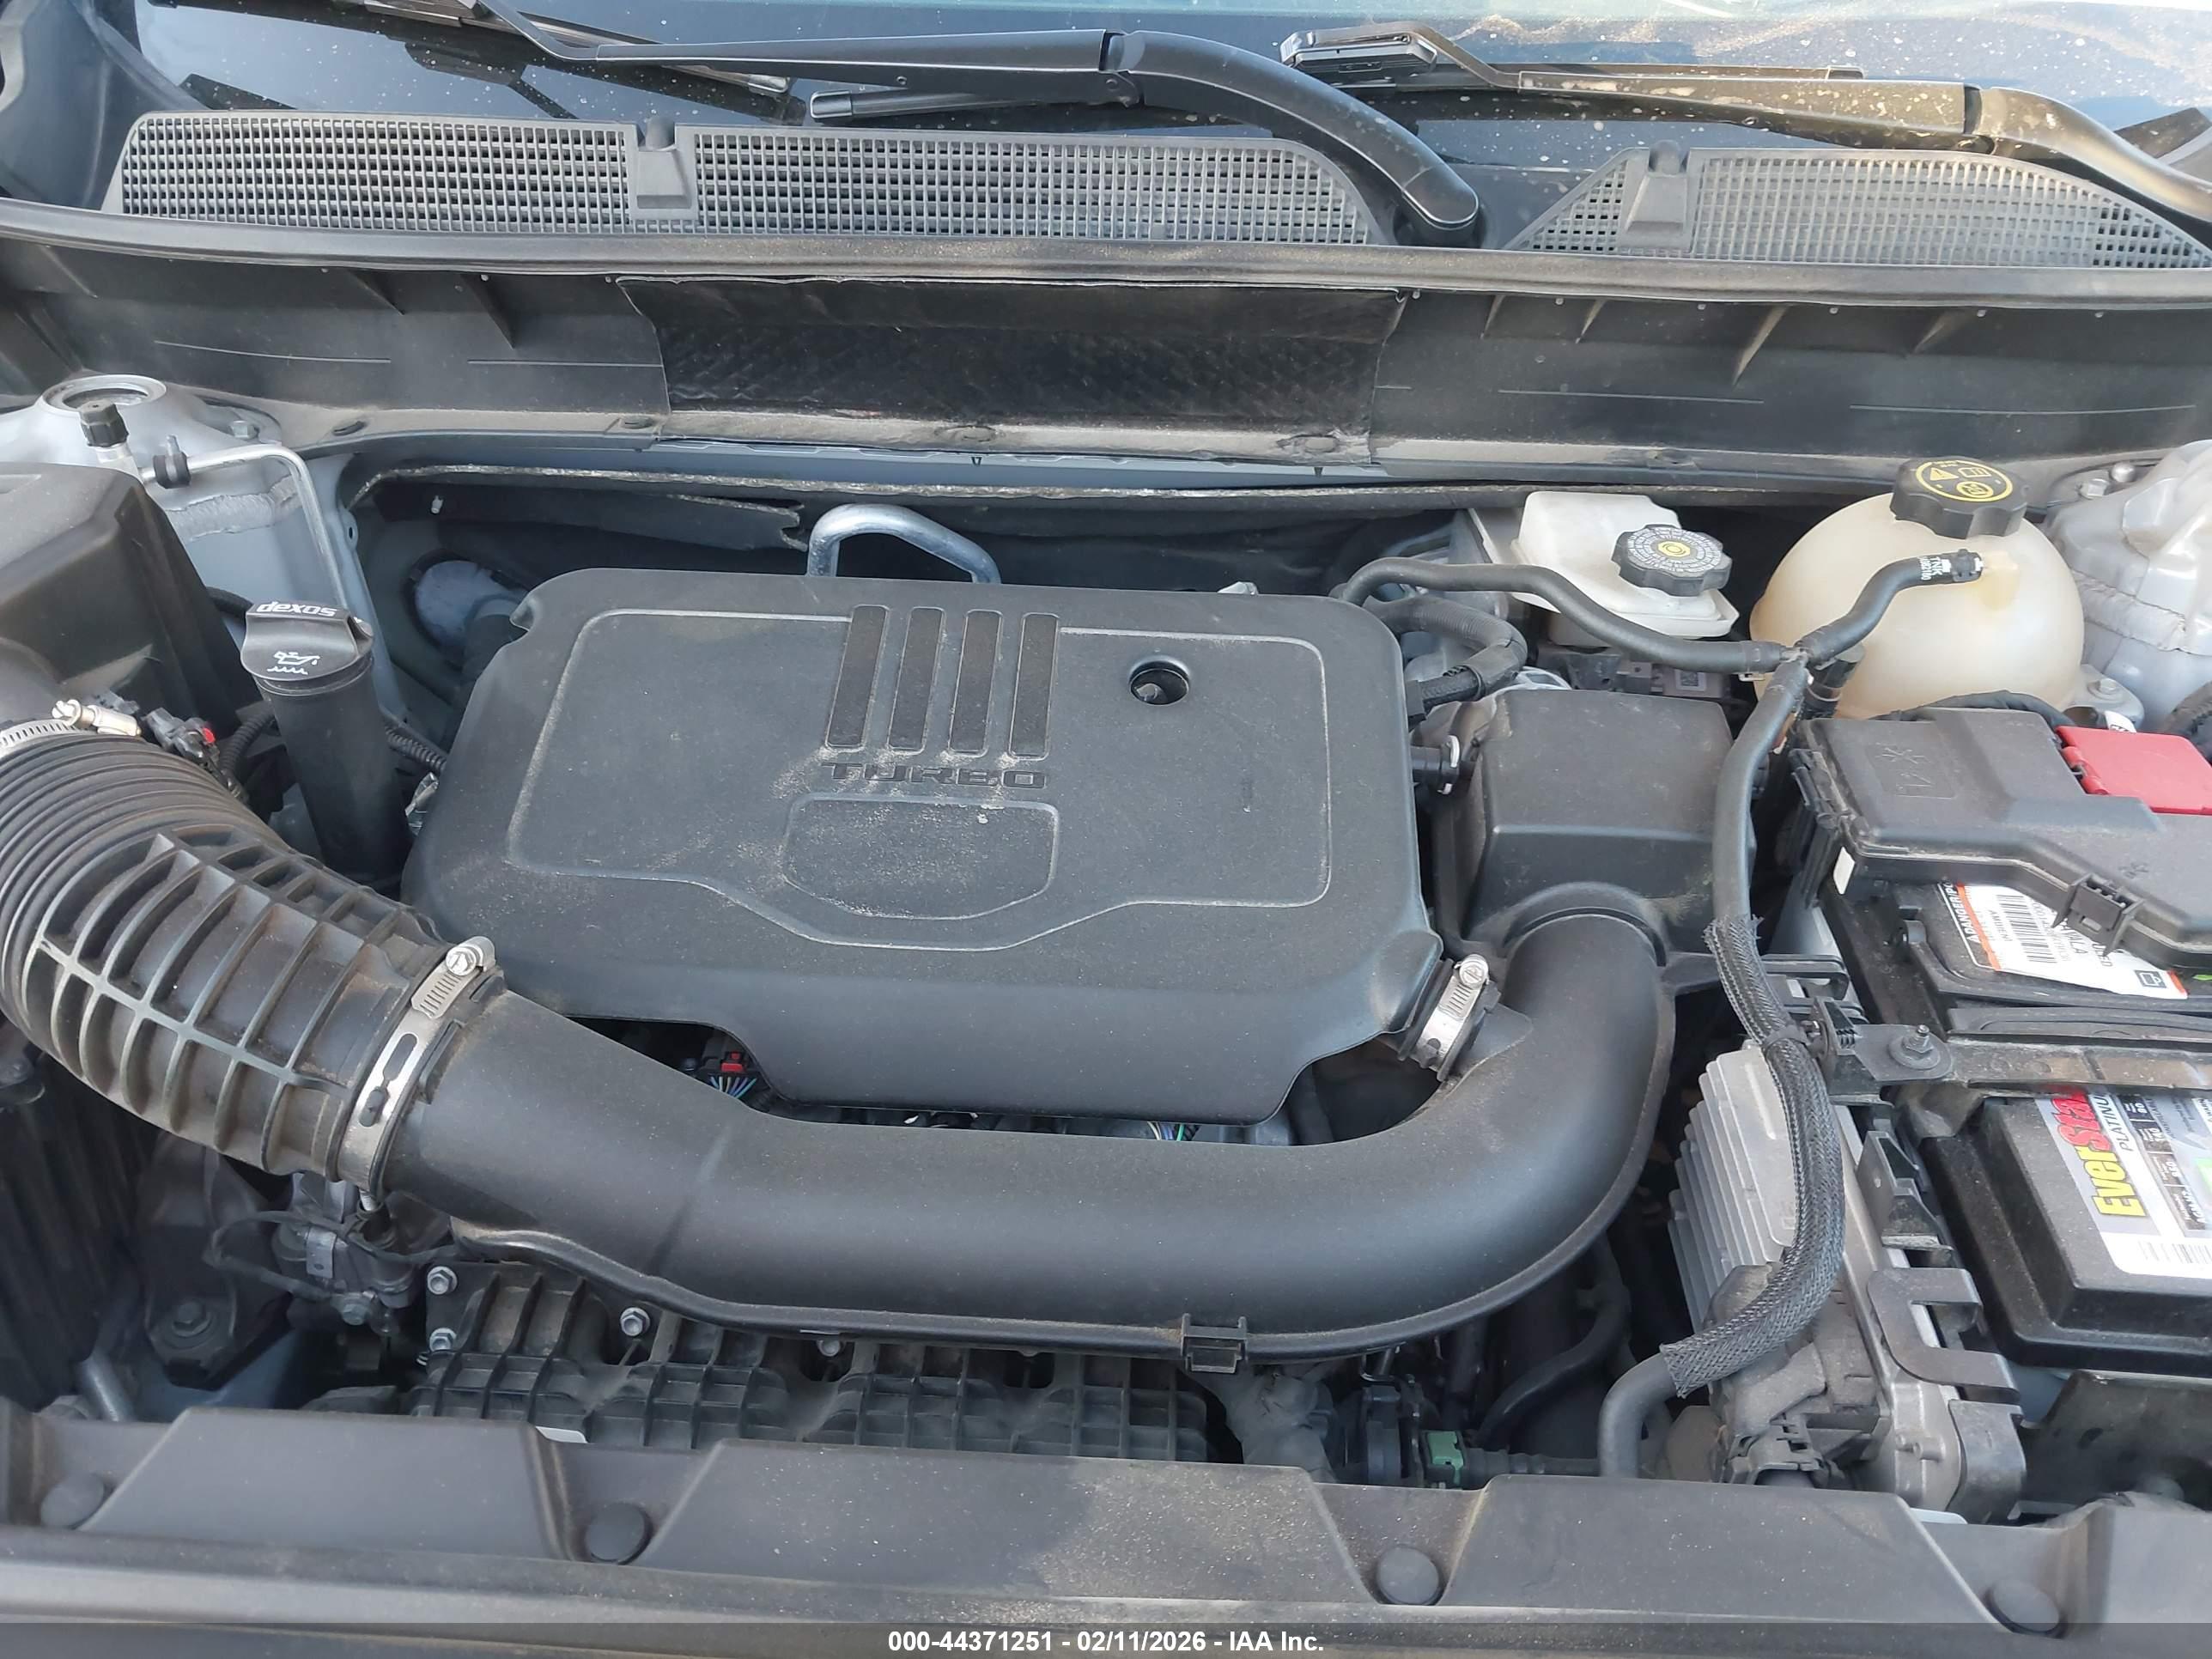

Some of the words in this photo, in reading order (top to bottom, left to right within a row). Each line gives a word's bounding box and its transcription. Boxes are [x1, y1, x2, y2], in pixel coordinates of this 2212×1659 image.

[257, 601, 338, 617] dexos
[819, 761, 1048, 790] TURBO
[2096, 1095, 2134, 1152] PLATINU
[2051, 1087, 2147, 1217] EverSta
